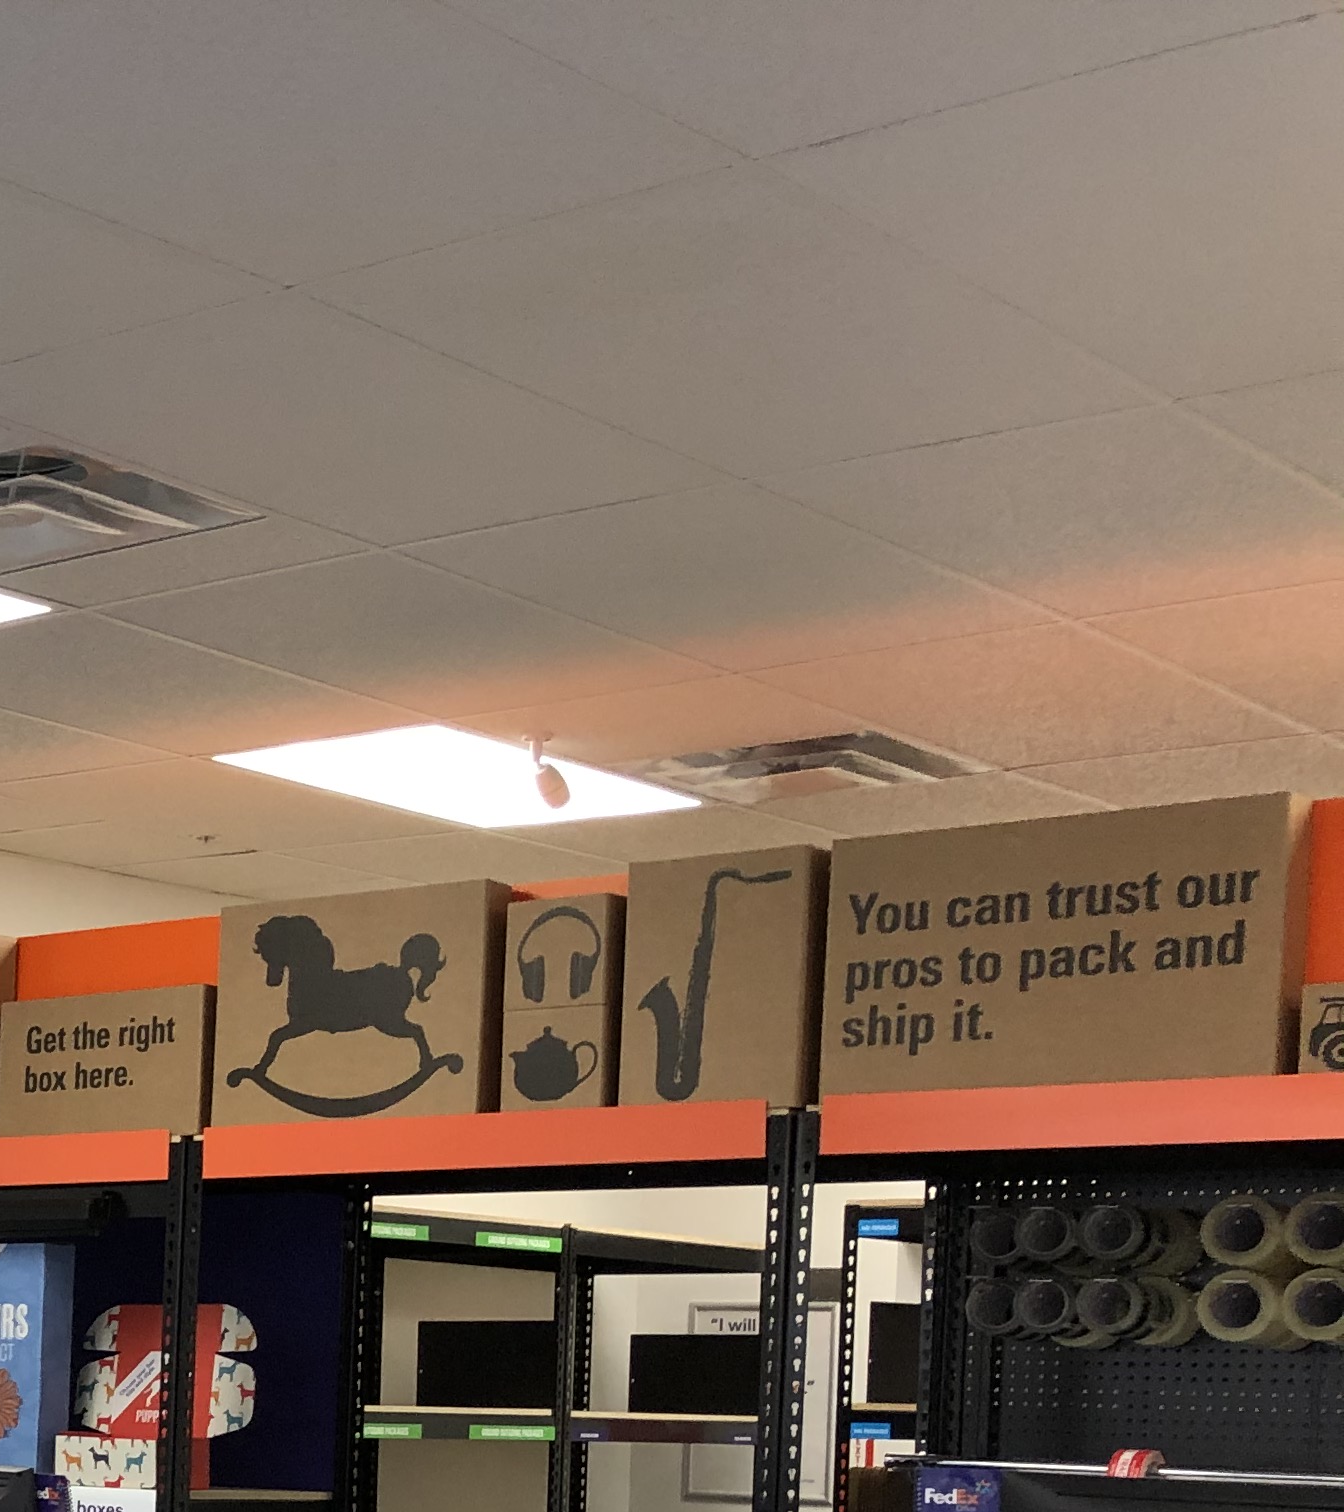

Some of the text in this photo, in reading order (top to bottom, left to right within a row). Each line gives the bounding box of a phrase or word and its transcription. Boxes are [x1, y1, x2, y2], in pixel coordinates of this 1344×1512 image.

[849, 868, 1261, 936] You can trust our
[844, 918, 1247, 1004] pros to pack and
[26, 1015, 176, 1054] Get the right
[841, 998, 995, 1056] ship it.
[24, 1061, 134, 1093] box here.
[727, 1317, 756, 1332] will
[924, 1487, 979, 1506] FedEx
